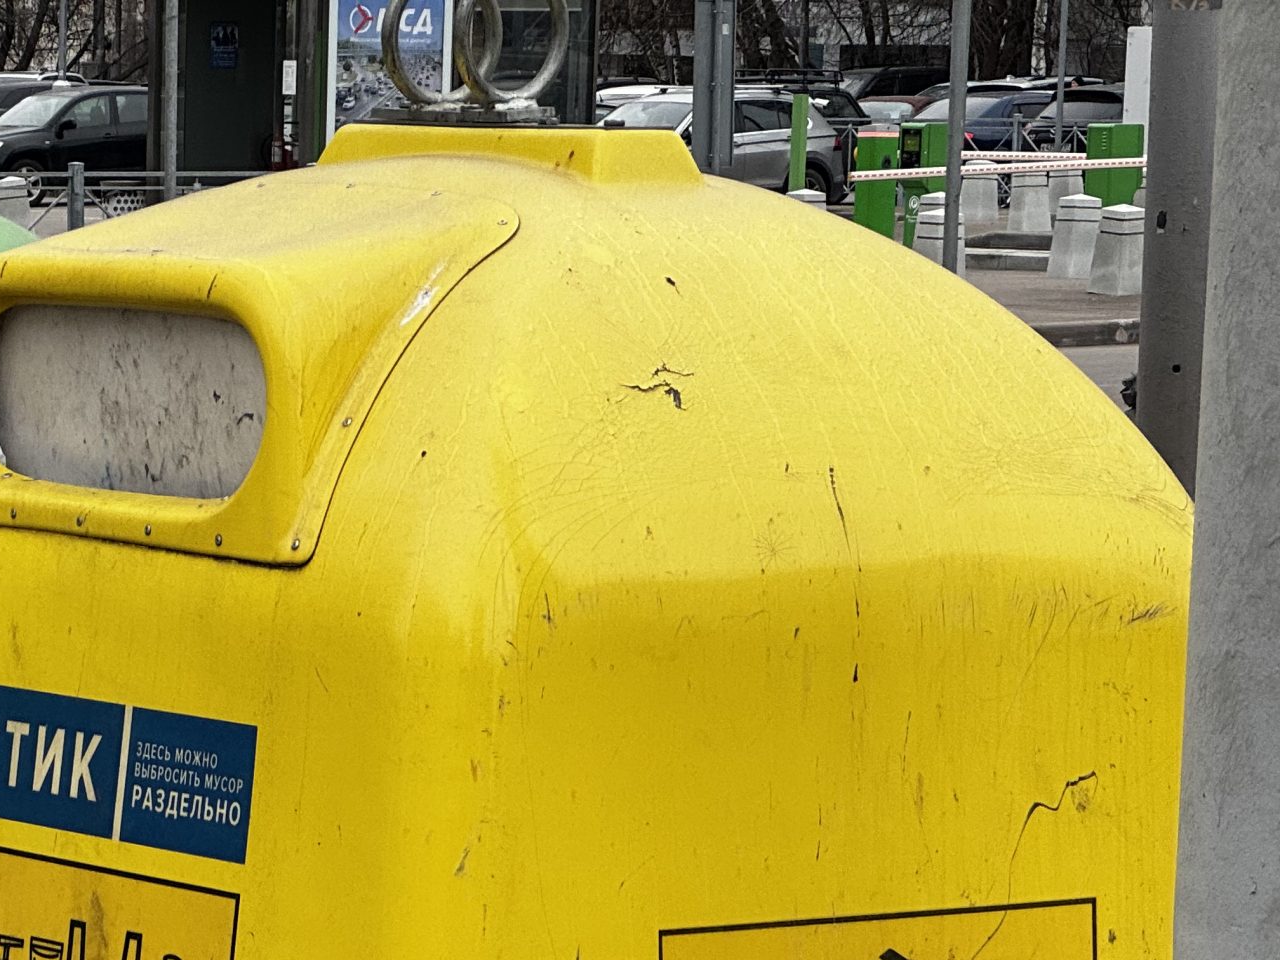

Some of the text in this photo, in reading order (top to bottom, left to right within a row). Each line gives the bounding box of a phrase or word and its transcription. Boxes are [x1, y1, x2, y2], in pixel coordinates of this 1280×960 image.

[136, 741, 218, 769] ЗДЕСЬ МОЖНО
[134, 762, 244, 794] ВЫБРОСИТЬ МУСОР
[131, 784, 241, 826] РАЗДЕЛЬНО
